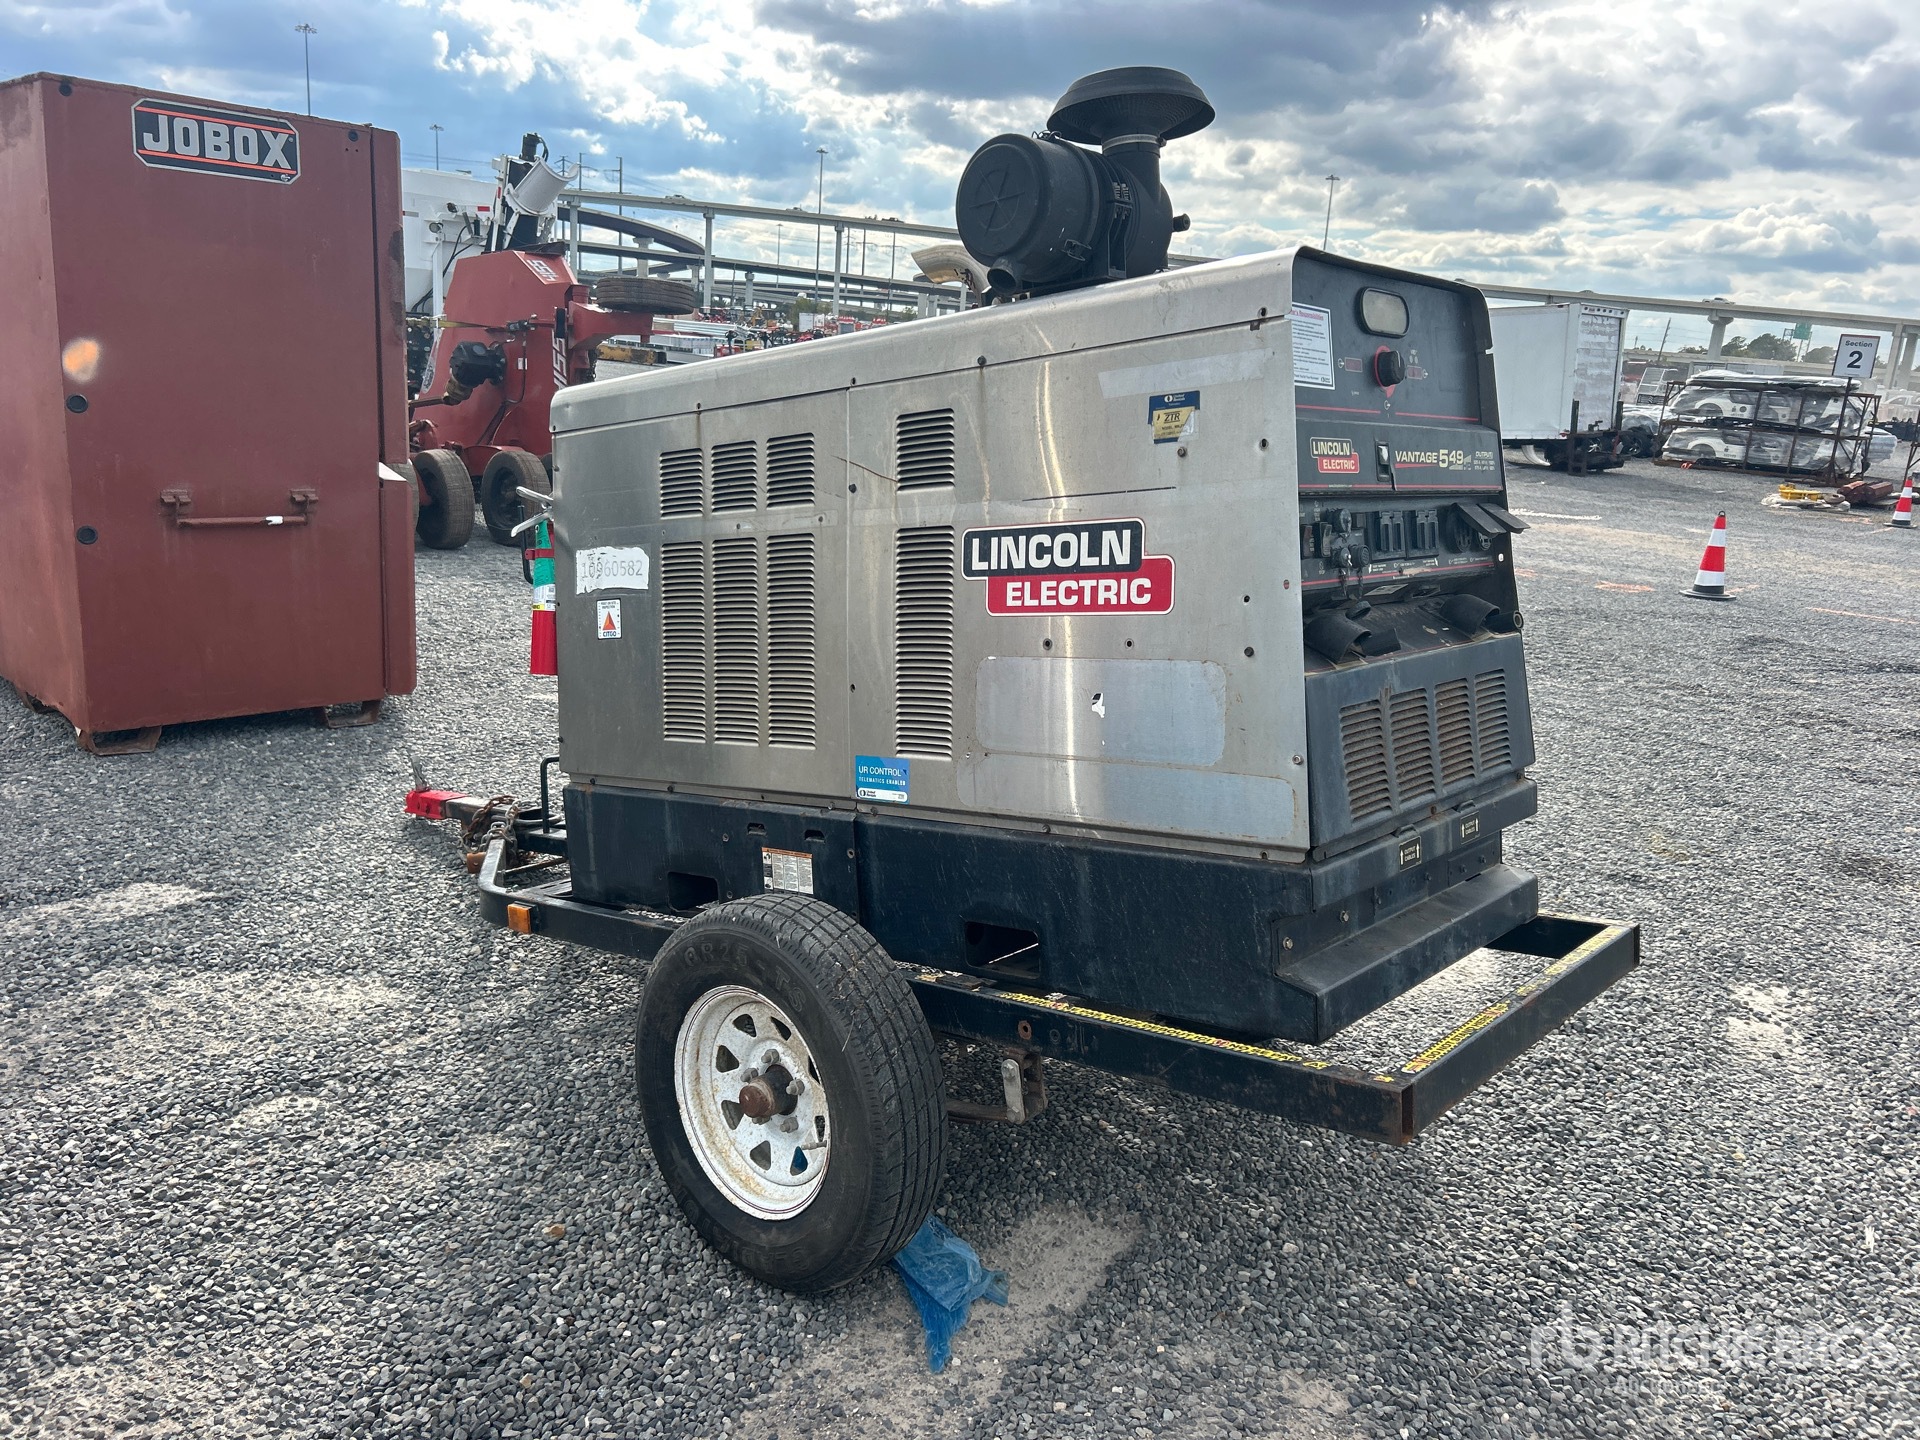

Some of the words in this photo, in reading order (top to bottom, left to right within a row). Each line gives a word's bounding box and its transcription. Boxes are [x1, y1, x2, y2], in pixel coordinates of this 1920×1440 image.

[144, 114, 291, 169] JOBOX
[1845, 340, 1873, 348] Section
[1847, 350, 1863, 369] 2
[1312, 441, 1350, 455] LINCOLN
[1323, 459, 1355, 470] ELECTRIC
[1395, 450, 1438, 463] VANTAGE
[1439, 449, 1464, 468] 549
[971, 529, 1131, 571] LINCOLN
[581, 560, 643, 579] 10960582
[1006, 577, 1152, 607] ELECTRIC
[858, 765, 869, 774] UR
[869, 767, 902, 777] CONTROL
